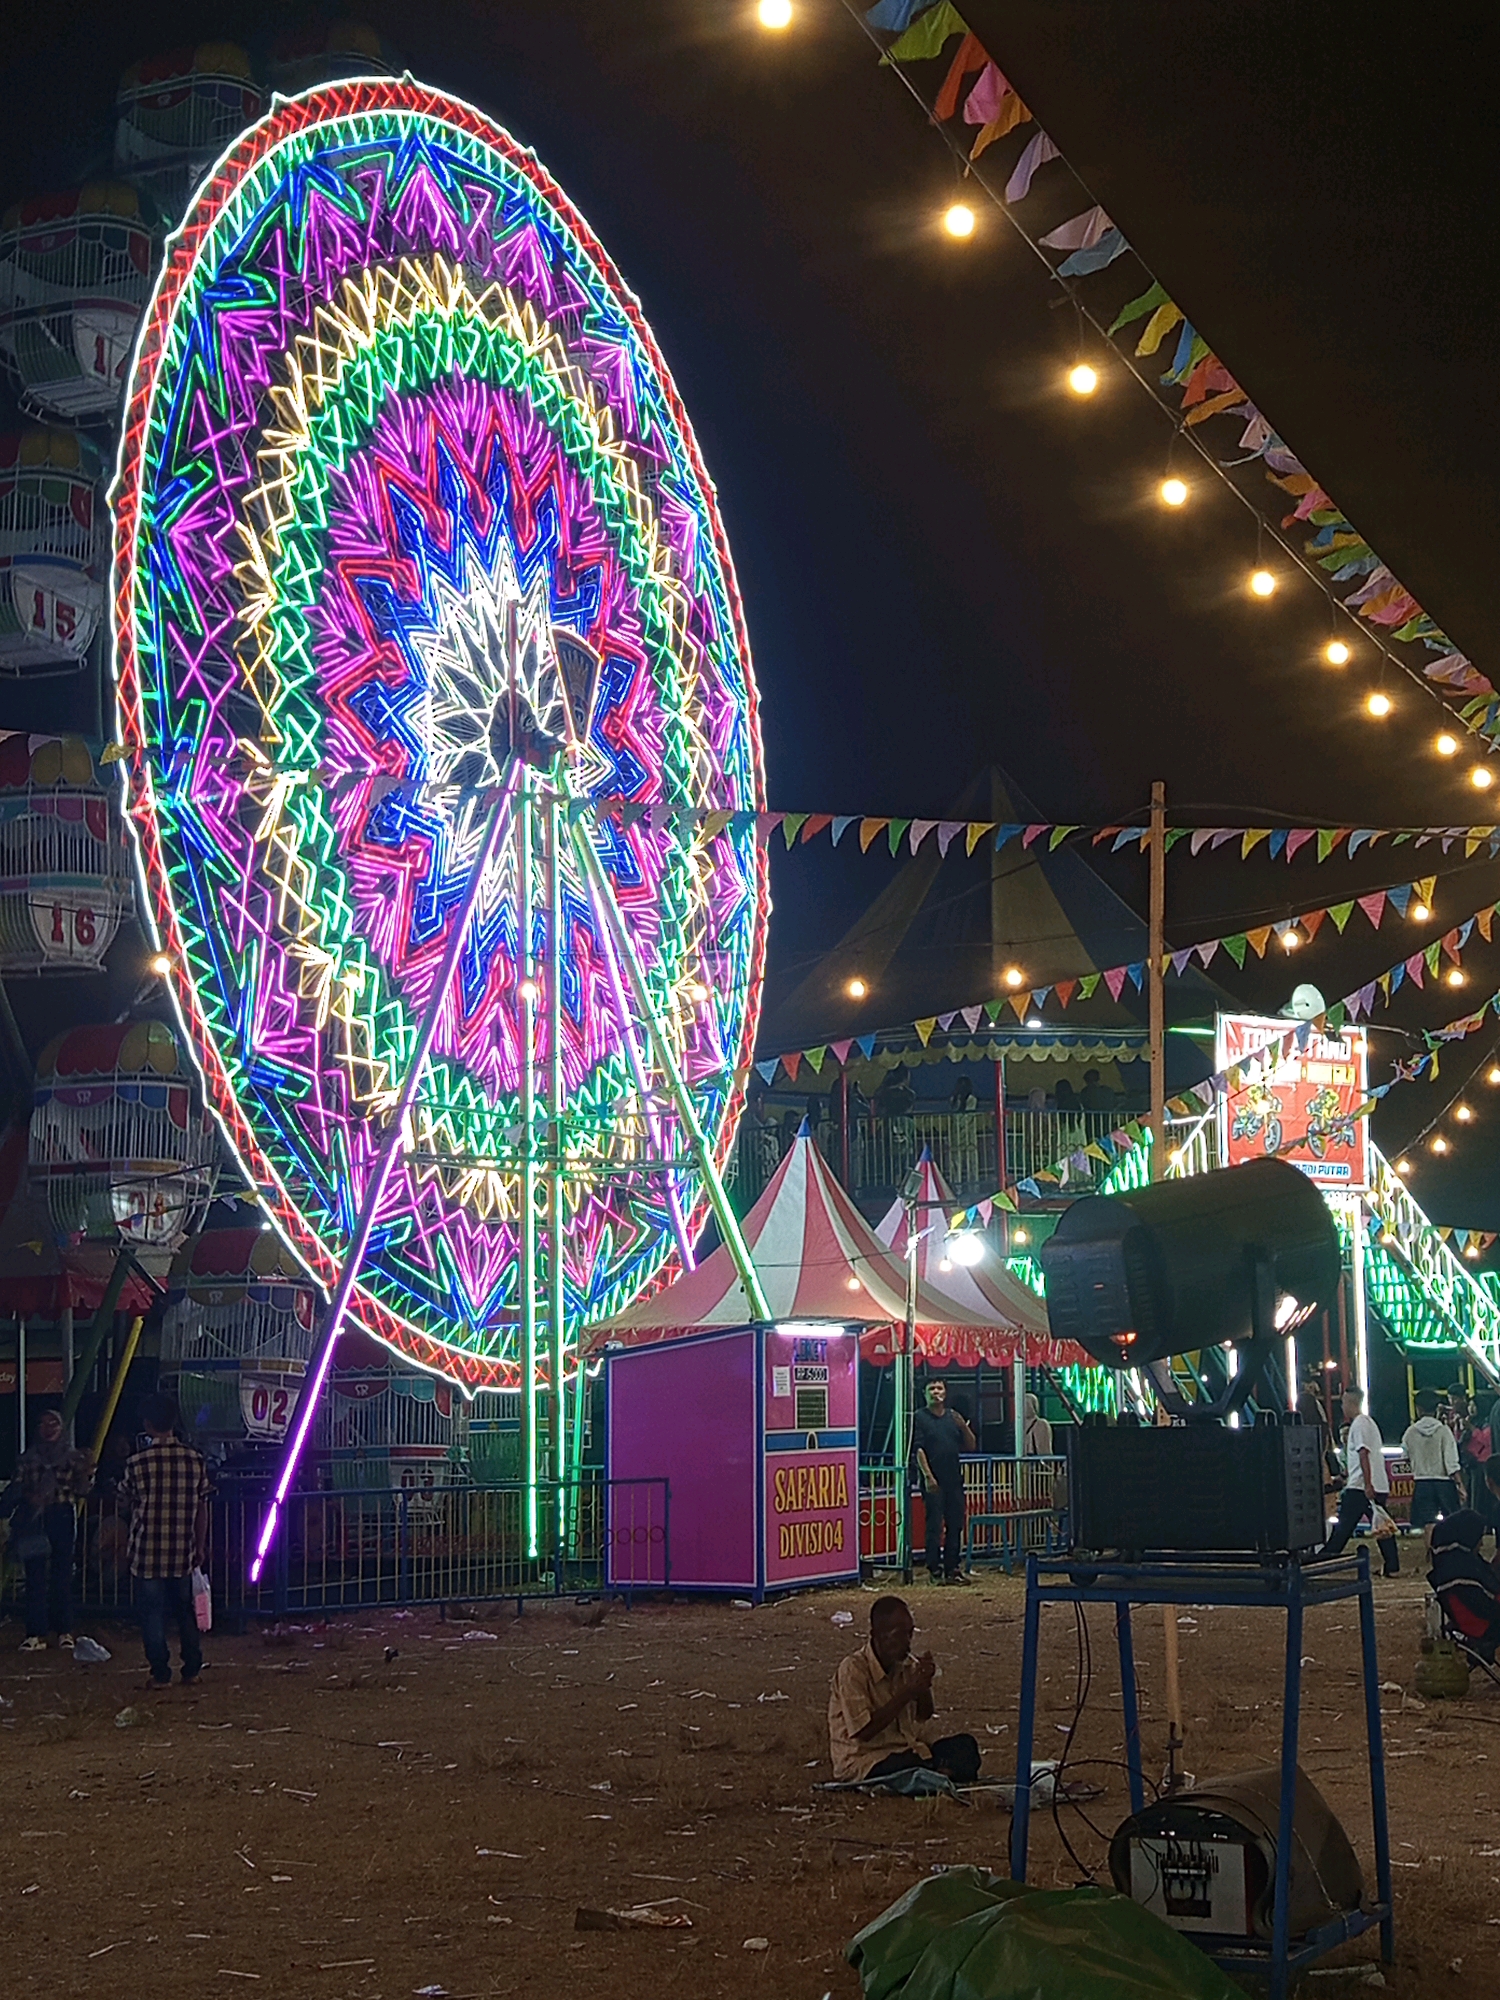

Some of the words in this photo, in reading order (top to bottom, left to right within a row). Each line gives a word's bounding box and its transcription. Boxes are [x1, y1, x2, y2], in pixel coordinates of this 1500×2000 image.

[33, 590, 76, 641] 15
[51, 901, 96, 946] 16
[1318, 1164, 1349, 1176] PUTRA
[252, 1386, 288, 1425] 02
[774, 1463, 849, 1514] SAFARIA
[779, 1521, 823, 1559] DIVISI
[823, 1518, 844, 1552] 04
